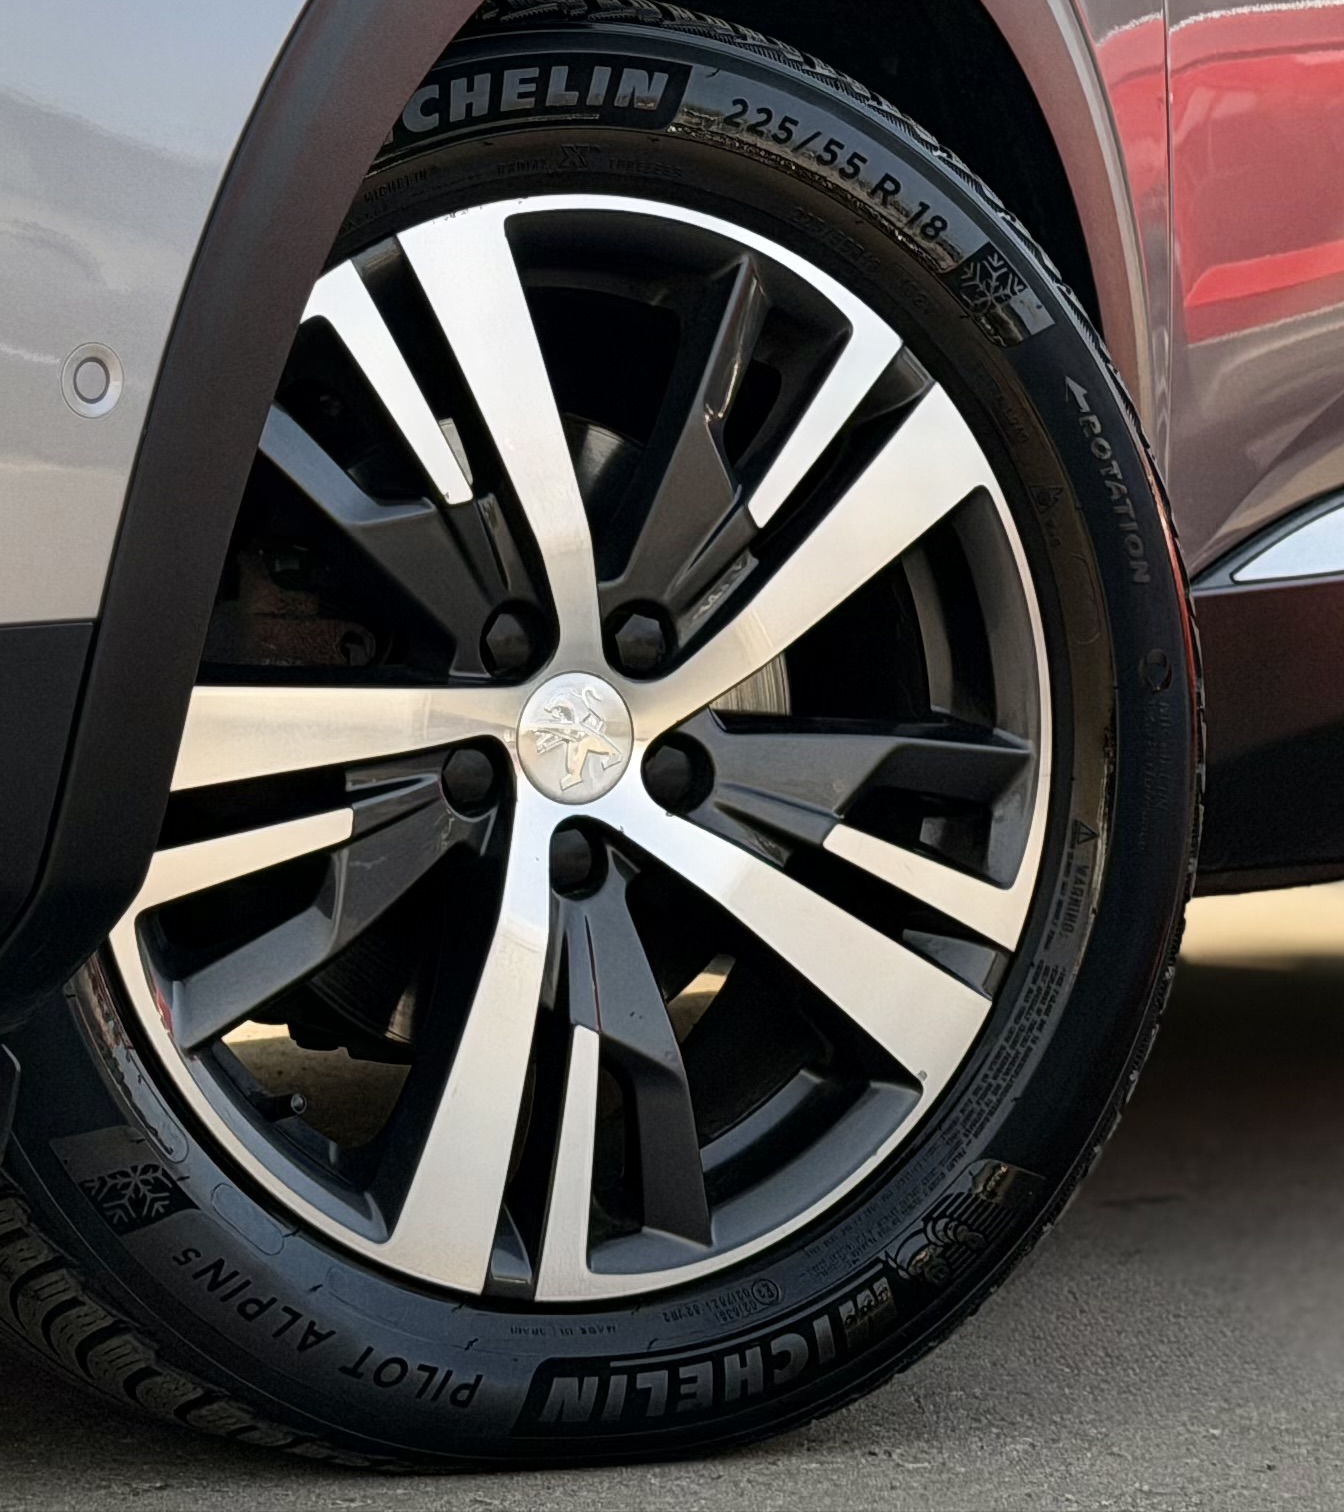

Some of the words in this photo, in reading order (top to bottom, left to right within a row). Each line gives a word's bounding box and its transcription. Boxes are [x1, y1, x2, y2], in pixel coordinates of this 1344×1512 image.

[384, 65, 669, 147] CHELIN
[723, 97, 862, 183] 225/55
[866, 171, 903, 208] R
[905, 202, 952, 240] 18
[1078, 414, 1151, 584] ROTATION
[338, 1345, 484, 1409] PILOT
[541, 1276, 897, 1423] MICHELIN
